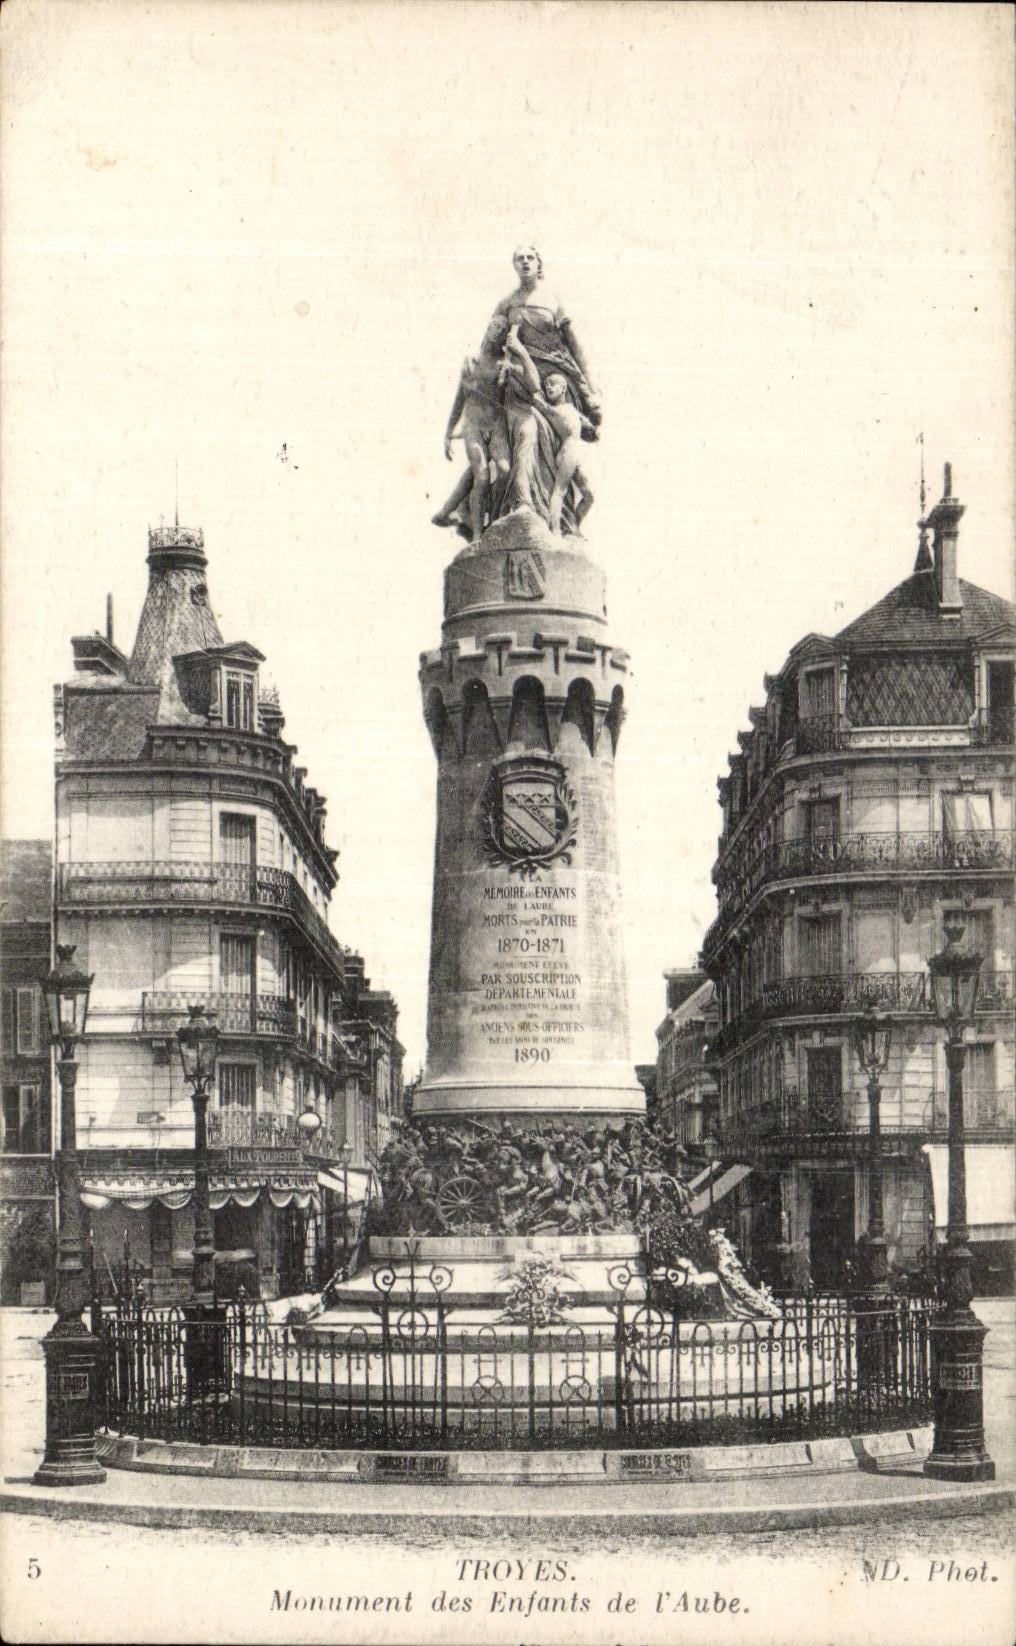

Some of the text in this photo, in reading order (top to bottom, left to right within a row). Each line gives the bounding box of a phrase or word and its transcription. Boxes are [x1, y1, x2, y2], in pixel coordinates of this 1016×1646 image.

[535, 886, 577, 899] ENFANTS
[482, 914, 518, 928] MORTS
[540, 914, 578, 927] PATRIE
[498, 938, 564, 953] 1870-1871
[480, 972, 582, 985] PAR SOUSCRIPTION
[514, 1047, 551, 1066] 1890
